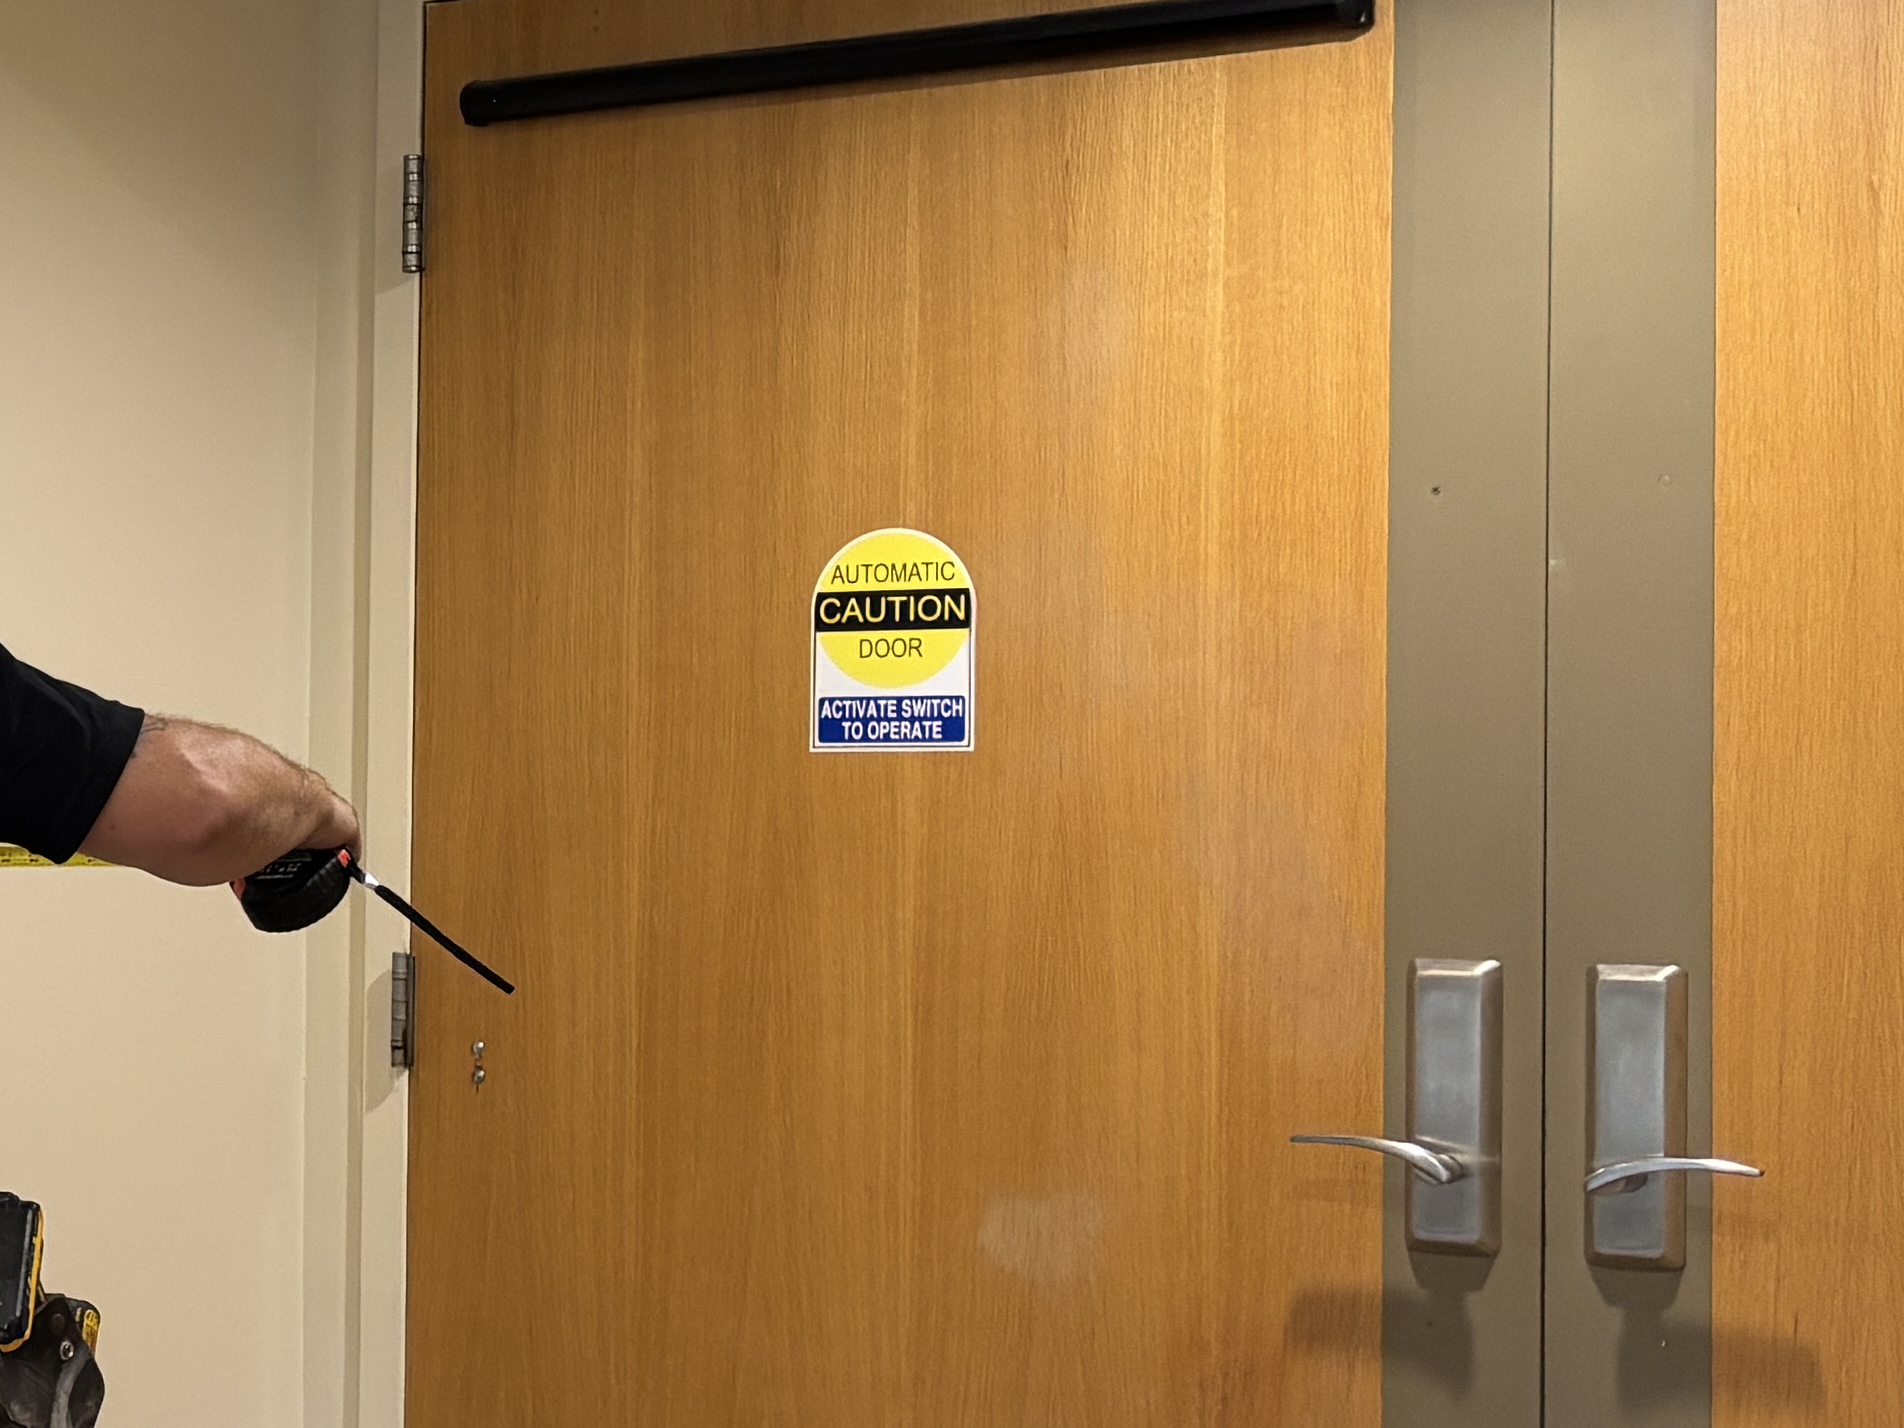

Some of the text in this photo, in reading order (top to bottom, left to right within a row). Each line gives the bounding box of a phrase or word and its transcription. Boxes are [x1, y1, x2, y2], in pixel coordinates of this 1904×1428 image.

[830, 560, 955, 585] AUTOMATIC
[819, 593, 966, 625] CAUTION
[859, 637, 923, 659] DOOR
[820, 698, 963, 719] ACTIVATE SWITCH
[842, 720, 943, 740] TO OPERATE
